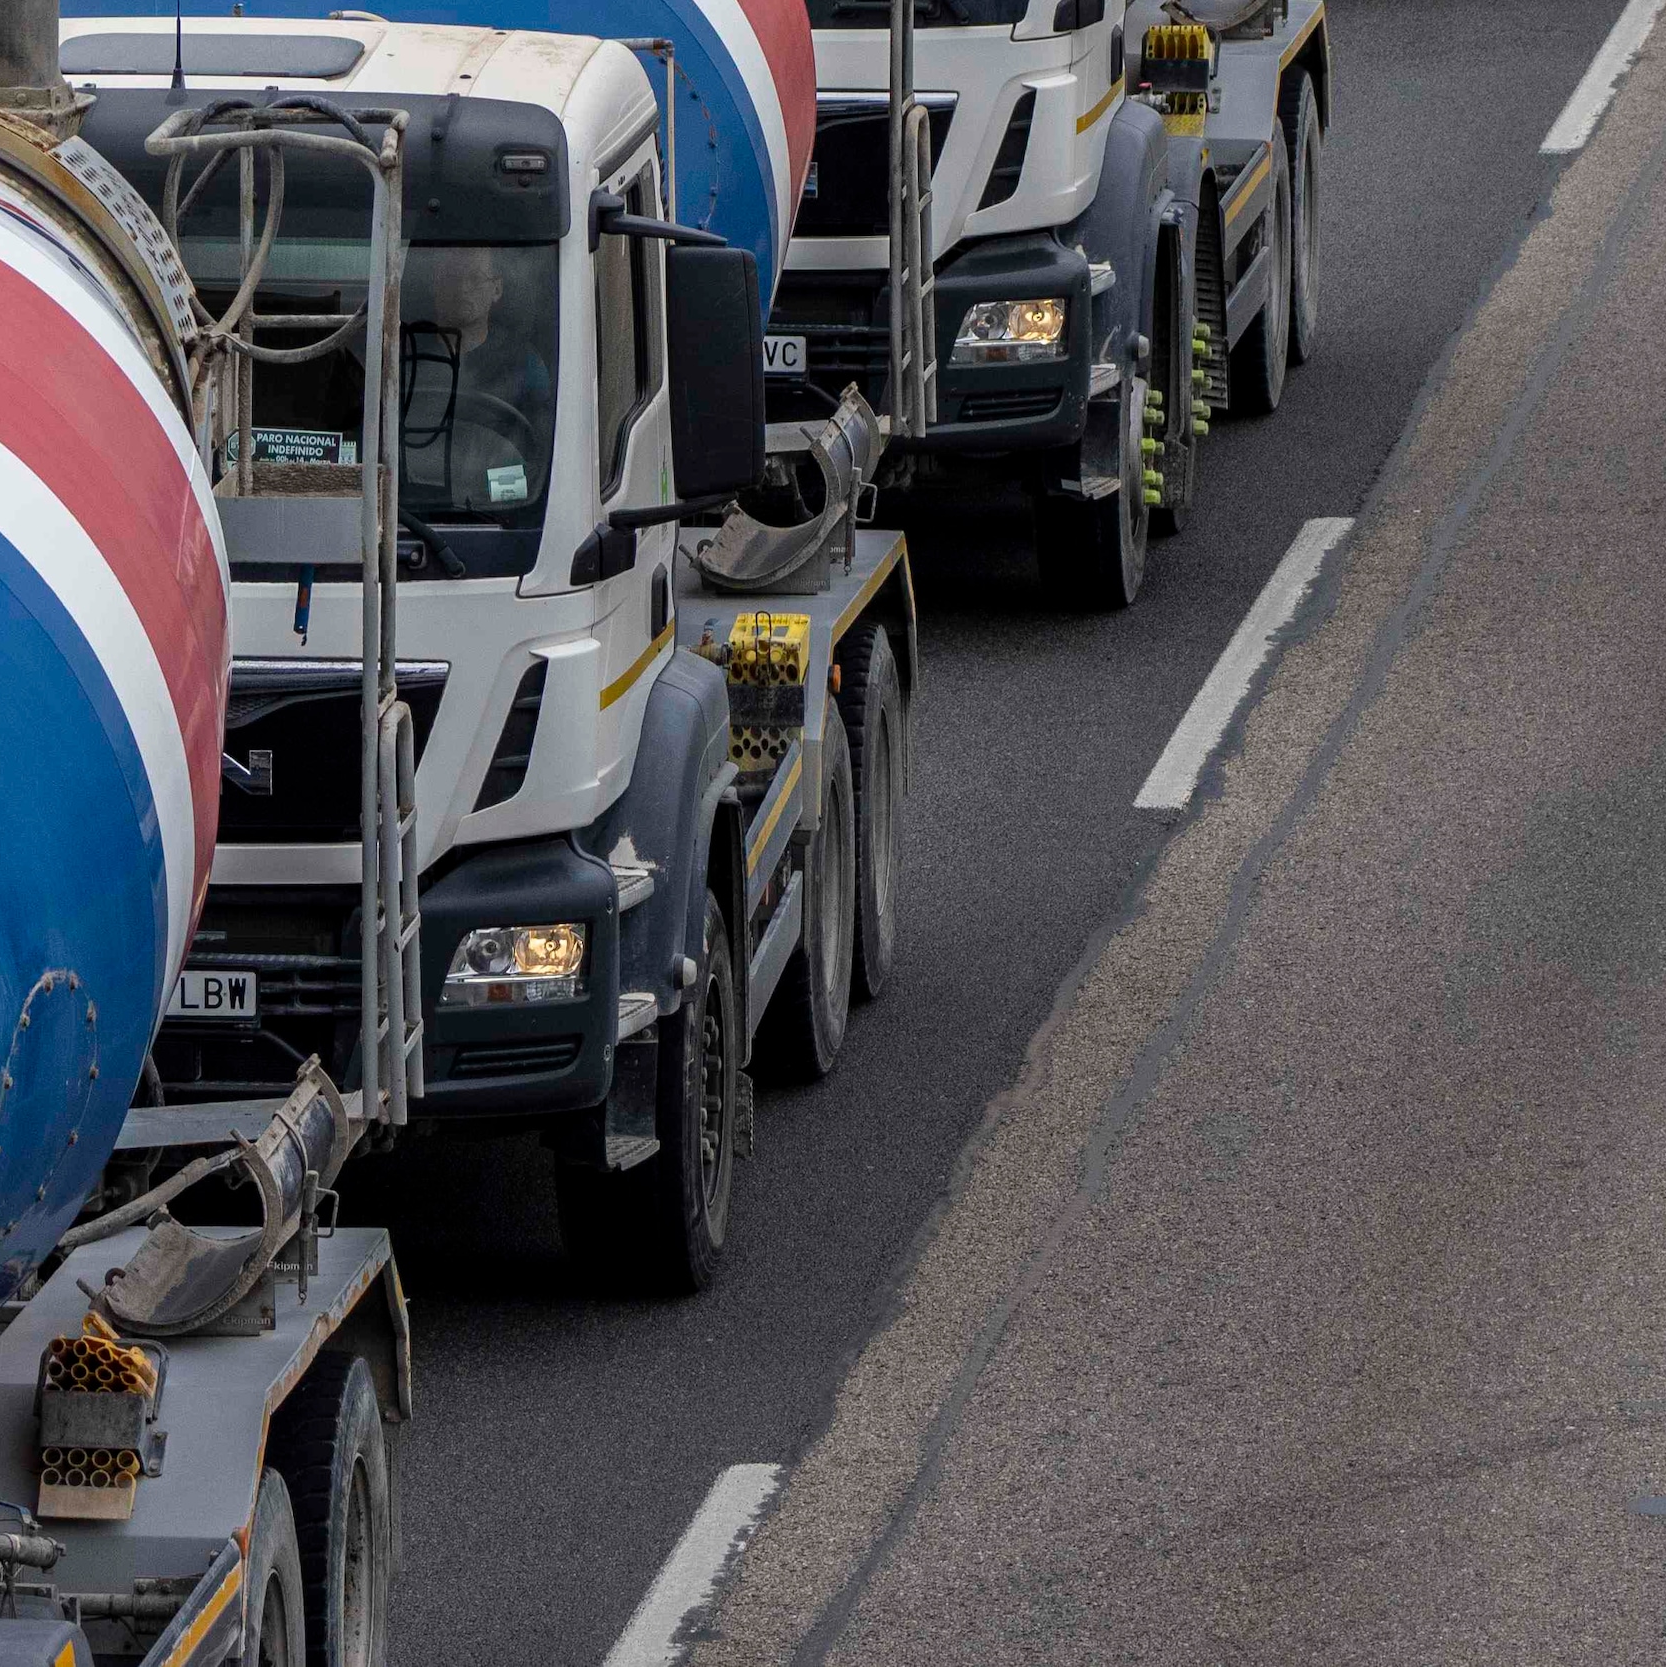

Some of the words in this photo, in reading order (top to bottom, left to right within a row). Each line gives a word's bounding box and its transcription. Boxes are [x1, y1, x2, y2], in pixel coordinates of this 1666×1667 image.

[256, 432, 283, 443] PARO
[285, 434, 337, 447] NACIONAL
[267, 444, 324, 456] INDEFINIDO
[180, 977, 247, 1010] LBW
